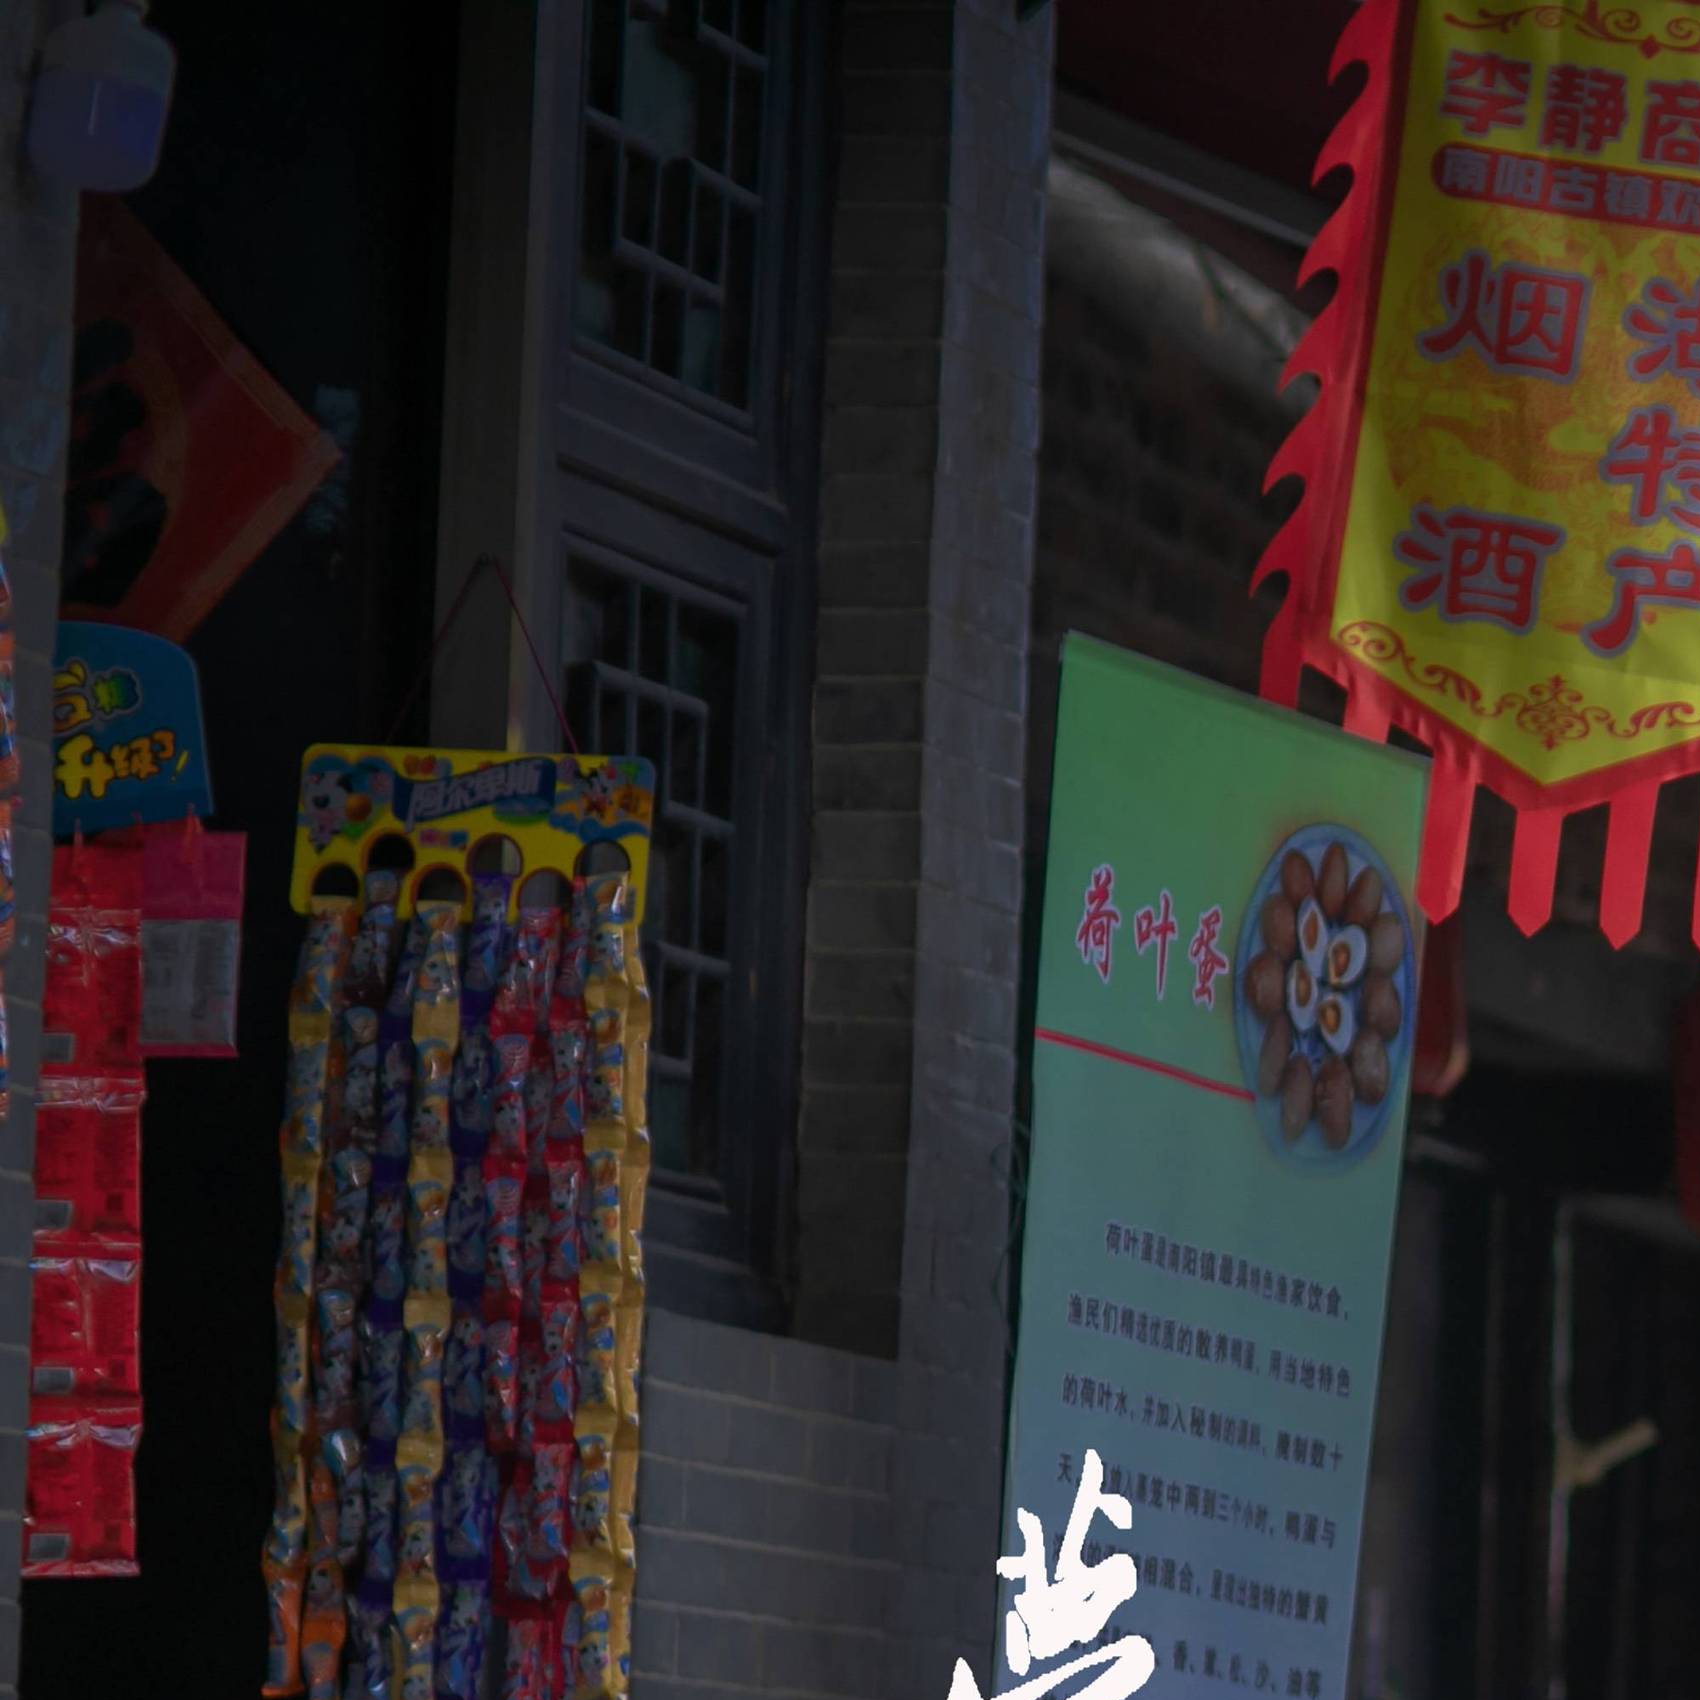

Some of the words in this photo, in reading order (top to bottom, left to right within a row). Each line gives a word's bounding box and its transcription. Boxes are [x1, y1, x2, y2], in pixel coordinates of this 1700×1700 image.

[1394, 248, 1594, 634] 烟酒
[1076, 862, 1231, 1010] 荷叶蛋
